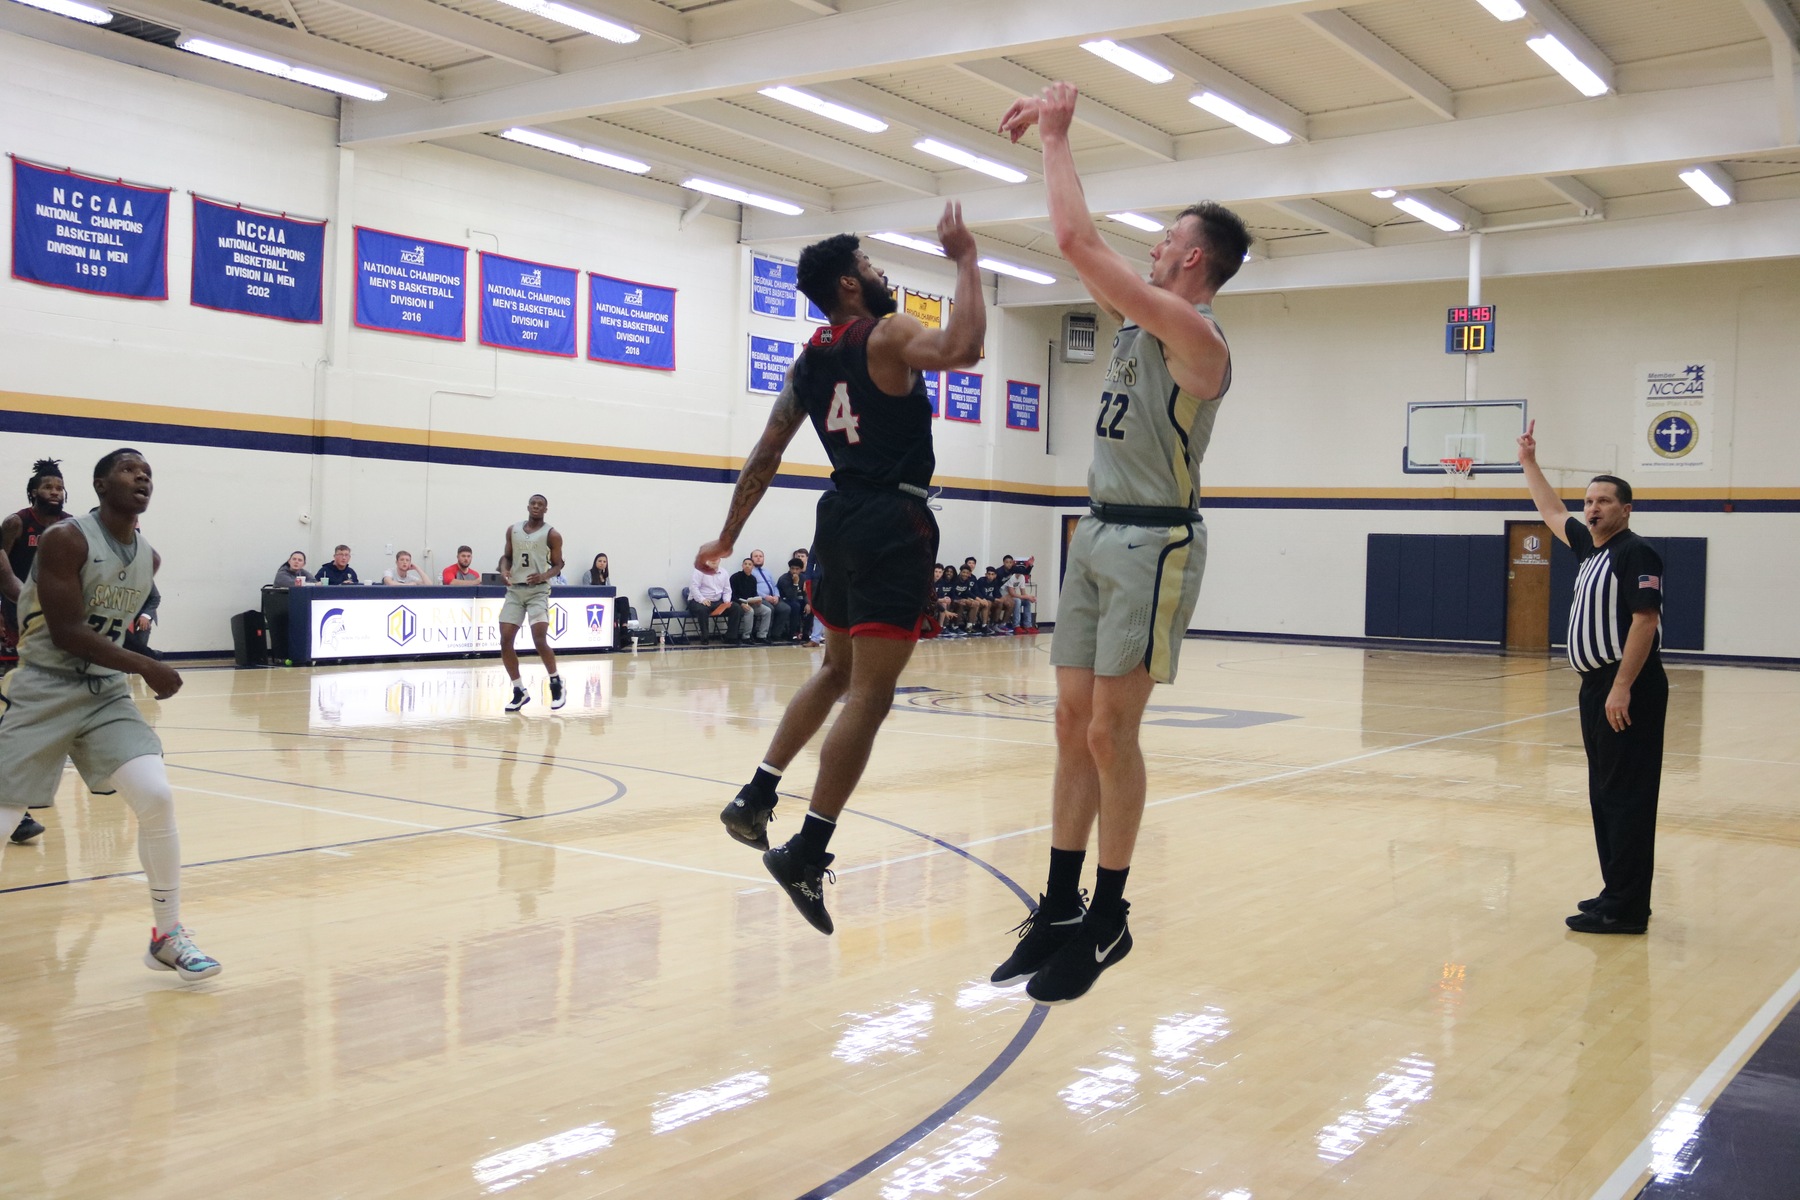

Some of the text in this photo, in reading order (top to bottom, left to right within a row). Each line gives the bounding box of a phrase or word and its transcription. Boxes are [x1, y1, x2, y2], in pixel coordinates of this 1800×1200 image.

[53, 187, 133, 216] NCCAA
[36, 203, 143, 234] NATIONAL CHAMPIONS
[56, 224, 123, 247] BASKETBALL
[237, 219, 286, 245] NCCAA
[47, 240, 128, 264] DIVISION IIA MEN
[218, 236, 305, 262] NATIONAL CHAMPIONS
[400, 252, 424, 264] NCCAA
[76, 262, 107, 277] 1999
[233, 252, 288, 272] BASKETBALL
[225, 265, 295, 287] DIVISION IIA MEN
[363, 261, 461, 286] NATIONAL CHAMPIONS
[520, 275, 541, 287] NCCAA
[754, 275, 774, 288] REGIONAL
[247, 284, 270, 298] 2002
[369, 276, 454, 299] MEN'S BASKETBALL
[487, 283, 571, 307] NATIONAL CHAMPIONS
[390, 294, 434, 310] DIVISION II
[492, 297, 567, 319] MEN'S BASKETBALL
[624, 294, 643, 305] NCCAA
[402, 311, 422, 322] 2016
[511, 315, 550, 329] DIVISION II
[596, 302, 669, 323] NATIONAL CHAMPIONS
[600, 316, 665, 334] MEN'S BASKETBALL
[522, 330, 538, 341] 2017
[616, 331, 650, 345] DIVISION II
[1463, 325, 1485, 350] 10
[625, 346, 640, 356] 2018
[1649, 381, 1704, 396] NCCAA
[826, 381, 861, 445] 4
[1096, 391, 1130, 440] 22
[521, 553, 530, 567] 3
